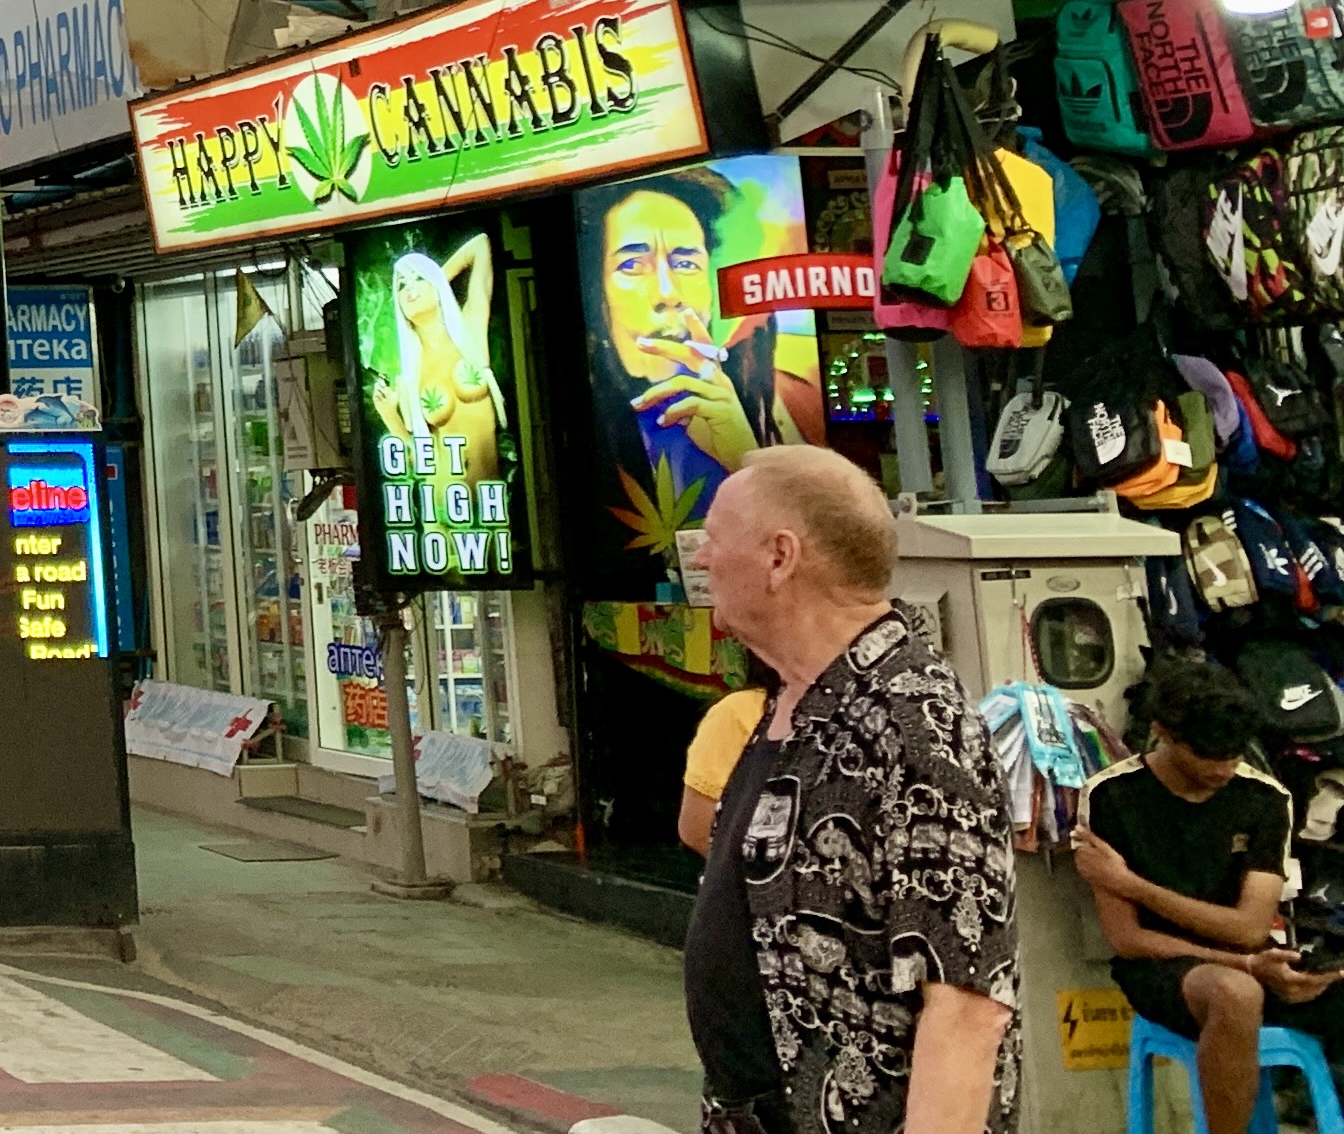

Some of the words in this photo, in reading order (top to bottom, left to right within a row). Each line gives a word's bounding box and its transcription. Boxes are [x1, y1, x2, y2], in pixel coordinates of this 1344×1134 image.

[1146, 0, 1187, 96] NORTH
[1175, 37, 1210, 92] THE
[166, 92, 292, 211] HAPPY
[367, 16, 641, 171] CANNABIS
[742, 265, 875, 307] SMIRNO
[379, 435, 467, 477] GET
[385, 481, 509, 526] HIGH
[34, 561, 87, 583] road
[388, 530, 512, 575] NOW!
[22, 590, 65, 611] Fun
